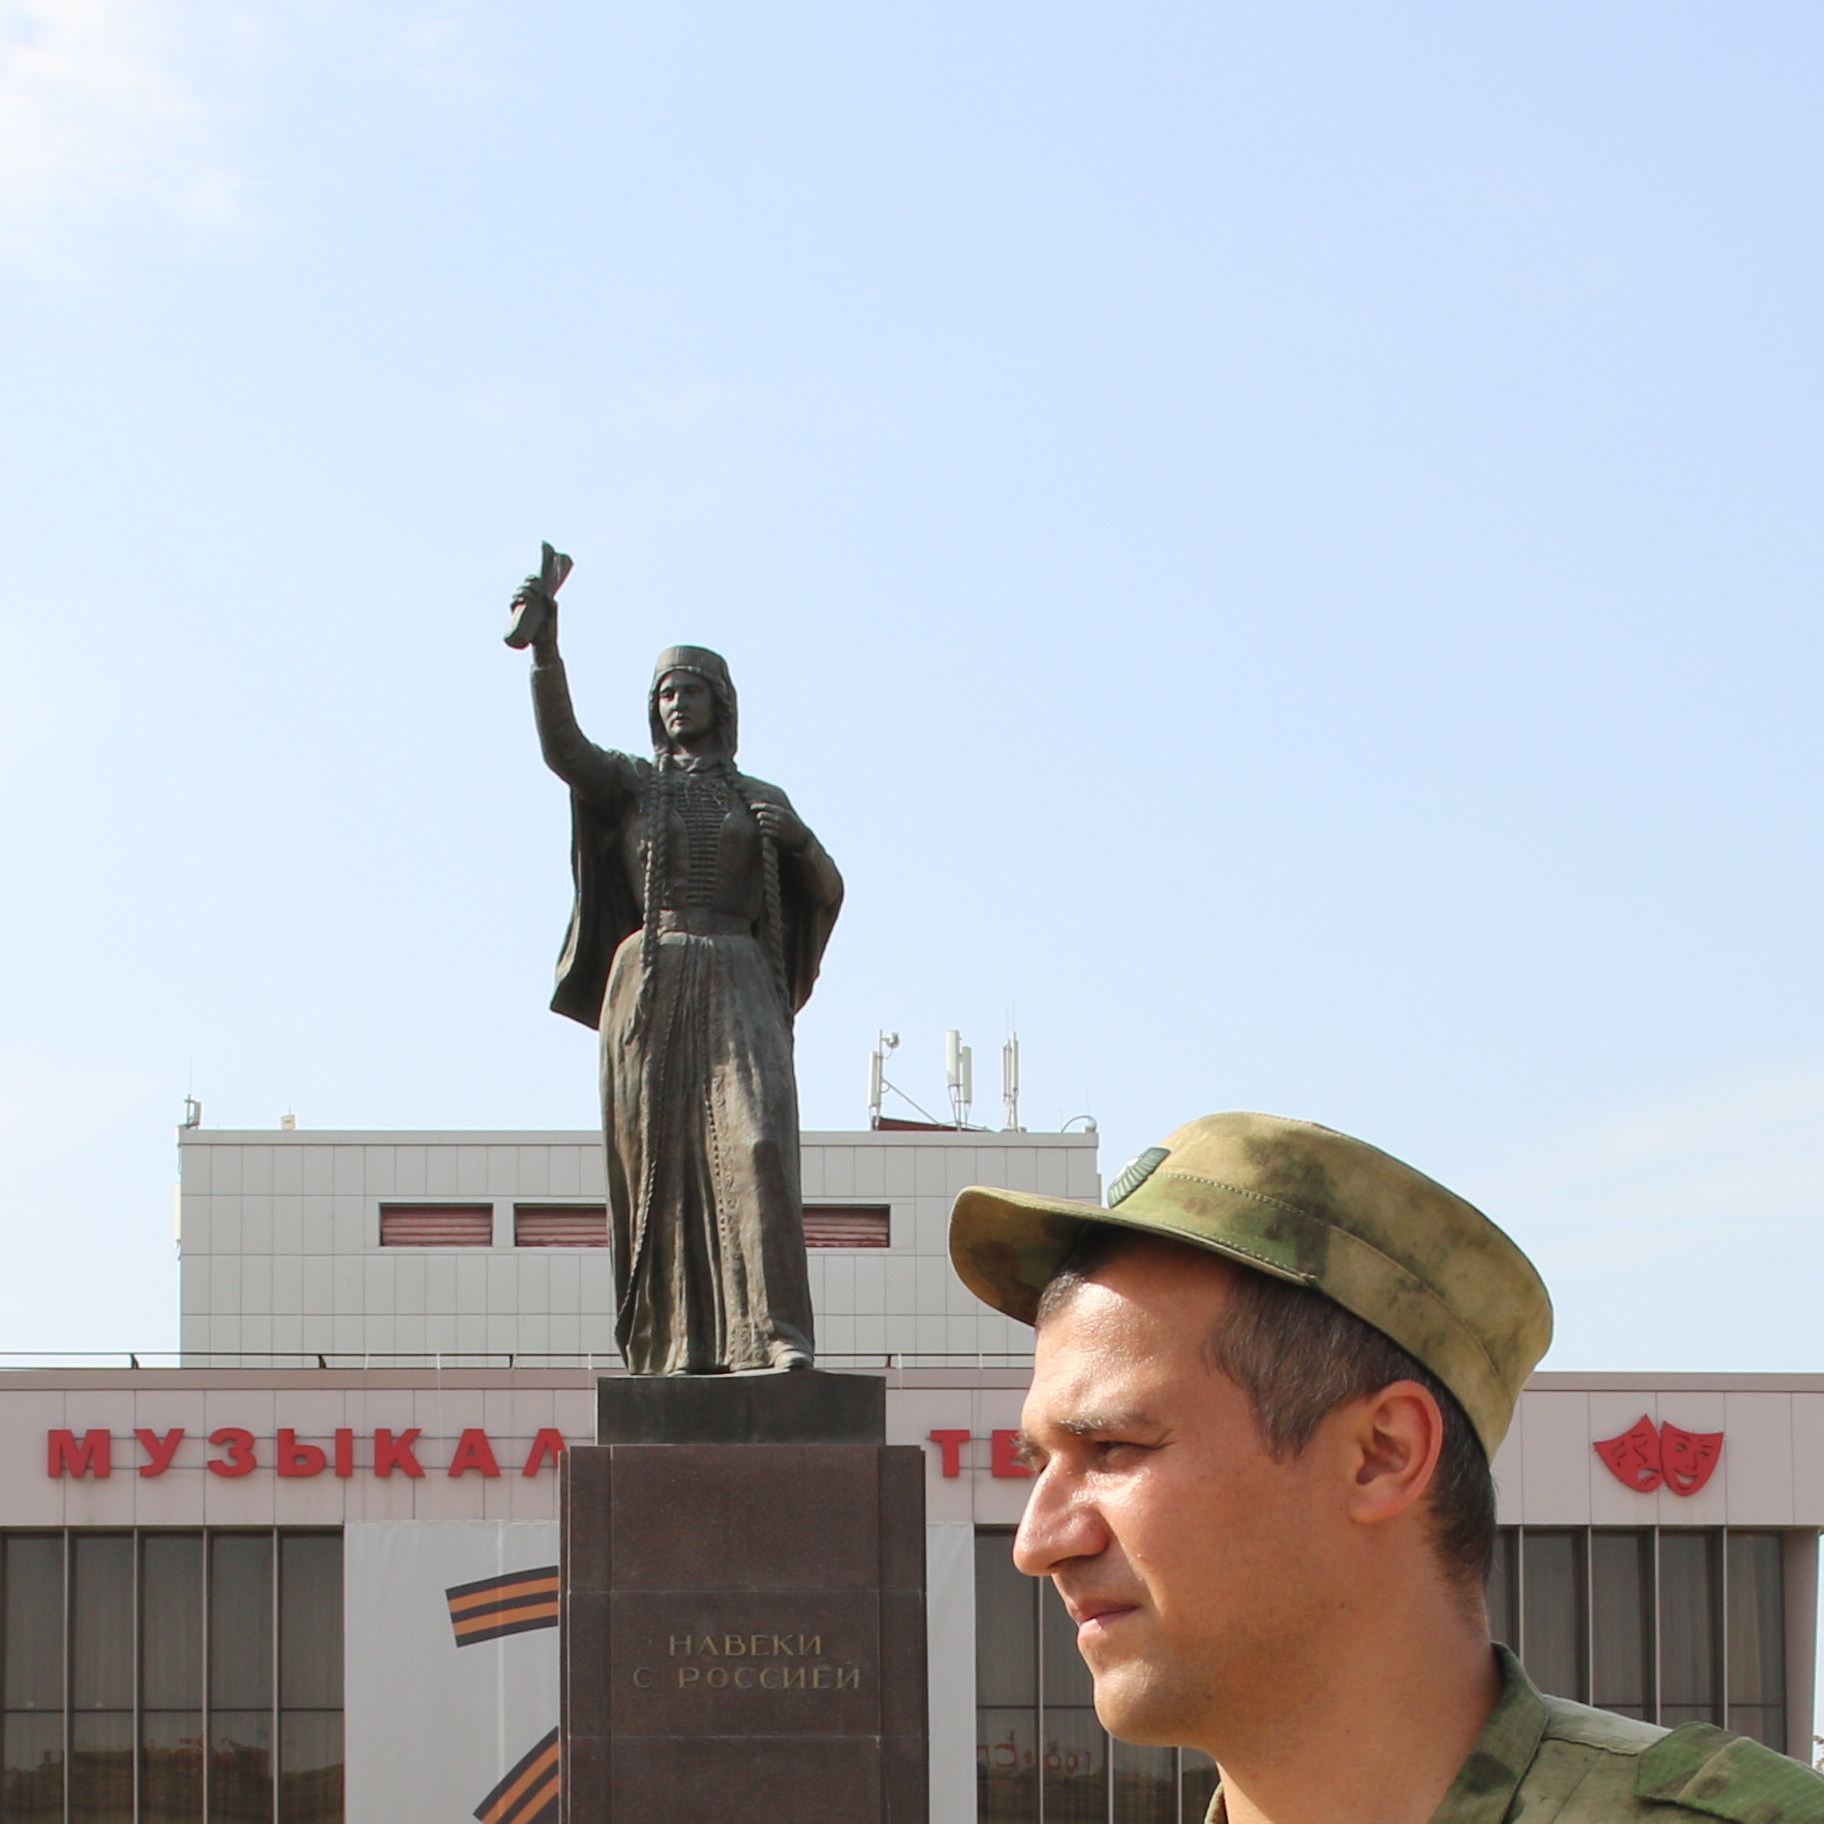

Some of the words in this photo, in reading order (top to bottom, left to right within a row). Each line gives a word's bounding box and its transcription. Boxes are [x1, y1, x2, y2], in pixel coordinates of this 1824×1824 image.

[669, 1634, 822, 1656] НАВЕКИ
[633, 1667, 652, 1688] С
[678, 1662, 860, 1689] РОССИЕЙ
